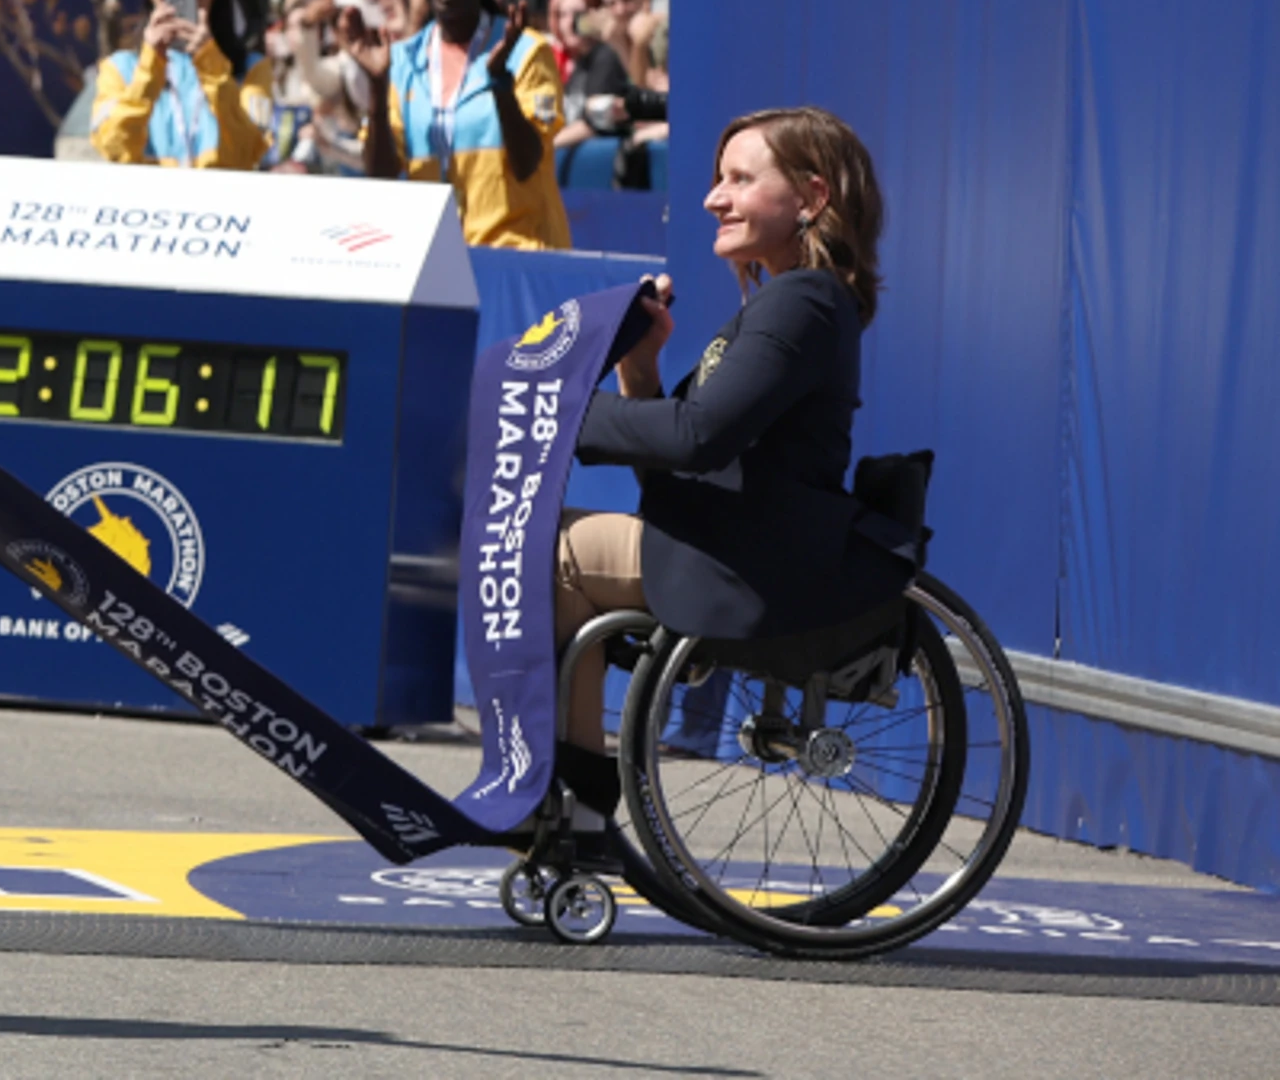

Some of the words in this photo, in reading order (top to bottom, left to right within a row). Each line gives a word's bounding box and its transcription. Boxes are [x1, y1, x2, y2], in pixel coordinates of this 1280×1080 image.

[0, 226, 241, 258] MARATHON
[95, 205, 251, 234] BOSTON
[133, 473, 197, 595] MARATHON
[478, 381, 529, 642] MARATHON
[500, 472, 542, 639] BOSTON
[97, 589, 178, 652] 128TH
[174, 650, 328, 763] BOSTON
